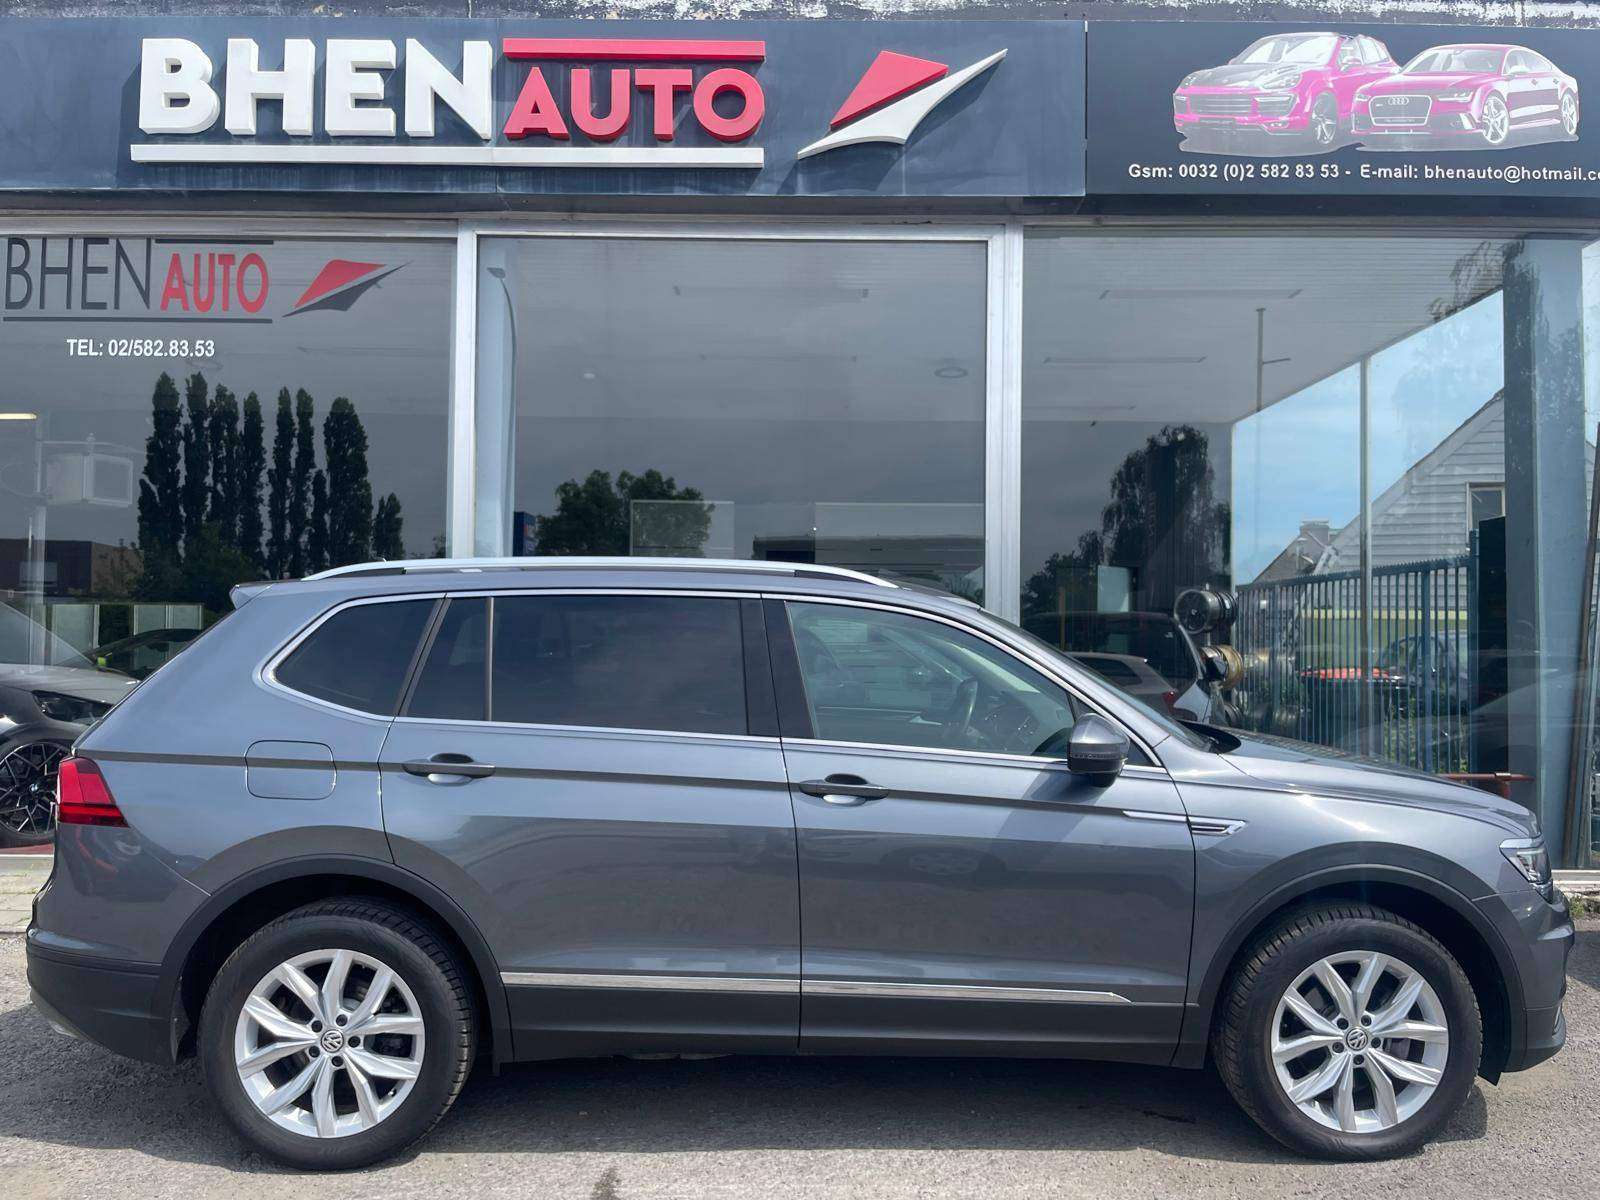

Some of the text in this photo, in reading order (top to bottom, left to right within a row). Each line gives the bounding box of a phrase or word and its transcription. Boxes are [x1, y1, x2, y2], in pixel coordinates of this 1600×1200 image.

[138, 38, 766, 142] BHEN AUTO
[1128, 163, 1173, 178] Gsm:
[1178, 164, 1218, 178] 0032
[1223, 164, 1255, 181] (0)2
[1260, 164, 1290, 178] 582
[1295, 164, 1315, 178] 83
[1320, 164, 1340, 178] 53
[1360, 163, 1419, 179] E-mail:
[1424, 164, 1600, 183] bhenauto@hotmail.c
[5, 236, 269, 314] BHEN AUTO
[66, 338, 216, 358] TEL: 02/582.83.53
